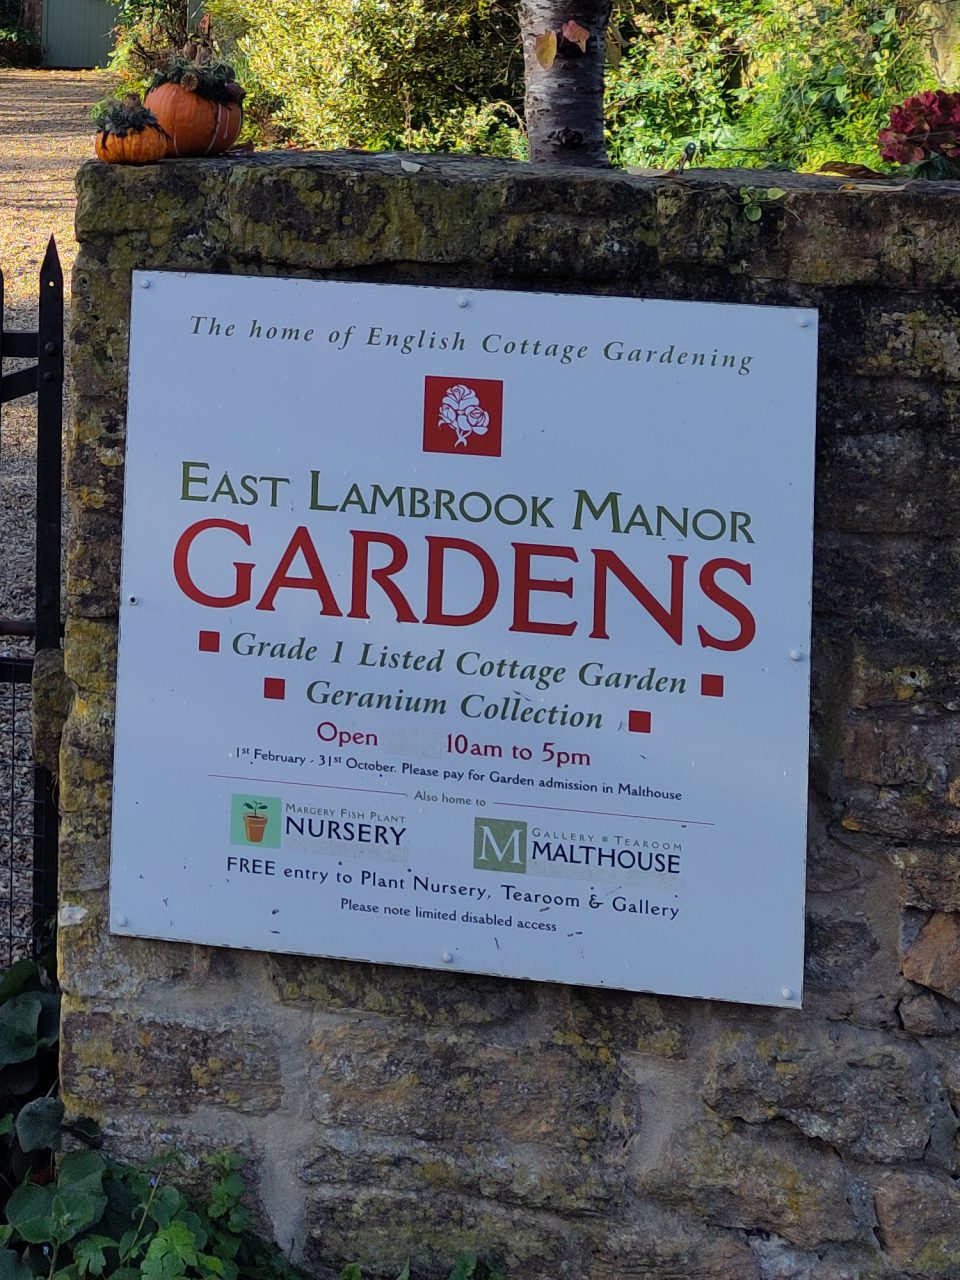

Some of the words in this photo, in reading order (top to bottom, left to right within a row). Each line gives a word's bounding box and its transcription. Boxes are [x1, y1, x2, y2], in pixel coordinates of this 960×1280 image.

[190, 316, 236, 336] The
[248, 320, 315, 342] home
[328, 325, 356, 350] of
[366, 327, 466, 354] English
[482, 334, 588, 364] Cottage
[603, 341, 754, 375] Gardening
[172, 517, 758, 652] GARDENS
[232, 632, 318, 662] Grade
[357, 642, 446, 673] Listed
[456, 651, 567, 690] Cottage
[578, 662, 688, 694] Garden
[306, 680, 447, 715] Geranium
[460, 694, 604, 730] Collection
[316, 721, 379, 748] Open
[446, 733, 503, 758] 10am
[512, 744, 533, 761] to
[541, 742, 591, 768] 5pm
[235, 747, 250, 758] 1st
[253, 748, 306, 766] February
[318, 754, 342, 767] 31st
[345, 757, 397, 774] October.
[401, 763, 439, 778] Please
[442, 770, 465, 781] pay
[468, 769, 486, 782] for
[489, 770, 534, 787] Garden
[538, 778, 598, 793] admission
[602, 783, 614, 794] in
[617, 783, 683, 802] Malthouse
[413, 790, 438, 803] Also
[441, 793, 472, 806] home
[475, 797, 487, 807] to
[285, 816, 407, 846] NURSERY
[477, 825, 524, 865] M
[531, 840, 681, 874] MALTHOUSE
[227, 856, 276, 876] FREE
[283, 867, 329, 885] entry
[336, 872, 353, 884] to
[361, 870, 405, 890] Plant
[413, 875, 492, 900] Nursery,
[500, 884, 581, 908] Tearoom
[588, 894, 604, 909] &
[612, 896, 680, 921] Gallery
[340, 897, 380, 914] Please
[383, 905, 411, 917] note
[415, 905, 457, 921] limited
[461, 910, 513, 928] disabled
[516, 919, 558, 933] access
